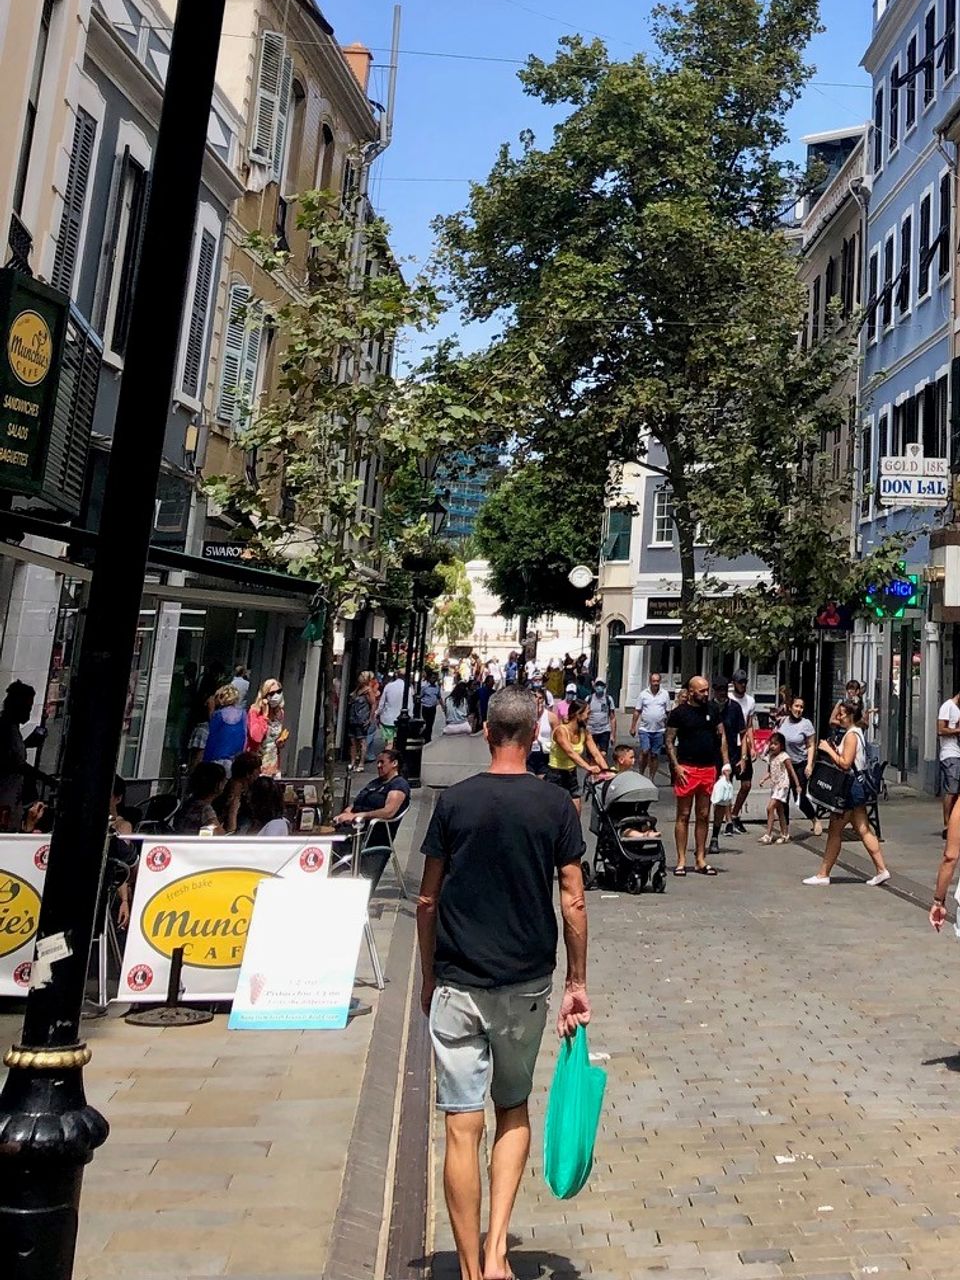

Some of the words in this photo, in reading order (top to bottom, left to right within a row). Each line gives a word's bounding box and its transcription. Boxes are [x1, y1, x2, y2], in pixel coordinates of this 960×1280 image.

[884, 460, 918, 471] GOLD
[882, 479, 912, 493] DON
[917, 480, 946, 495] LAL
[166, 885, 190, 901] fresh
[192, 879, 213, 890] bake
